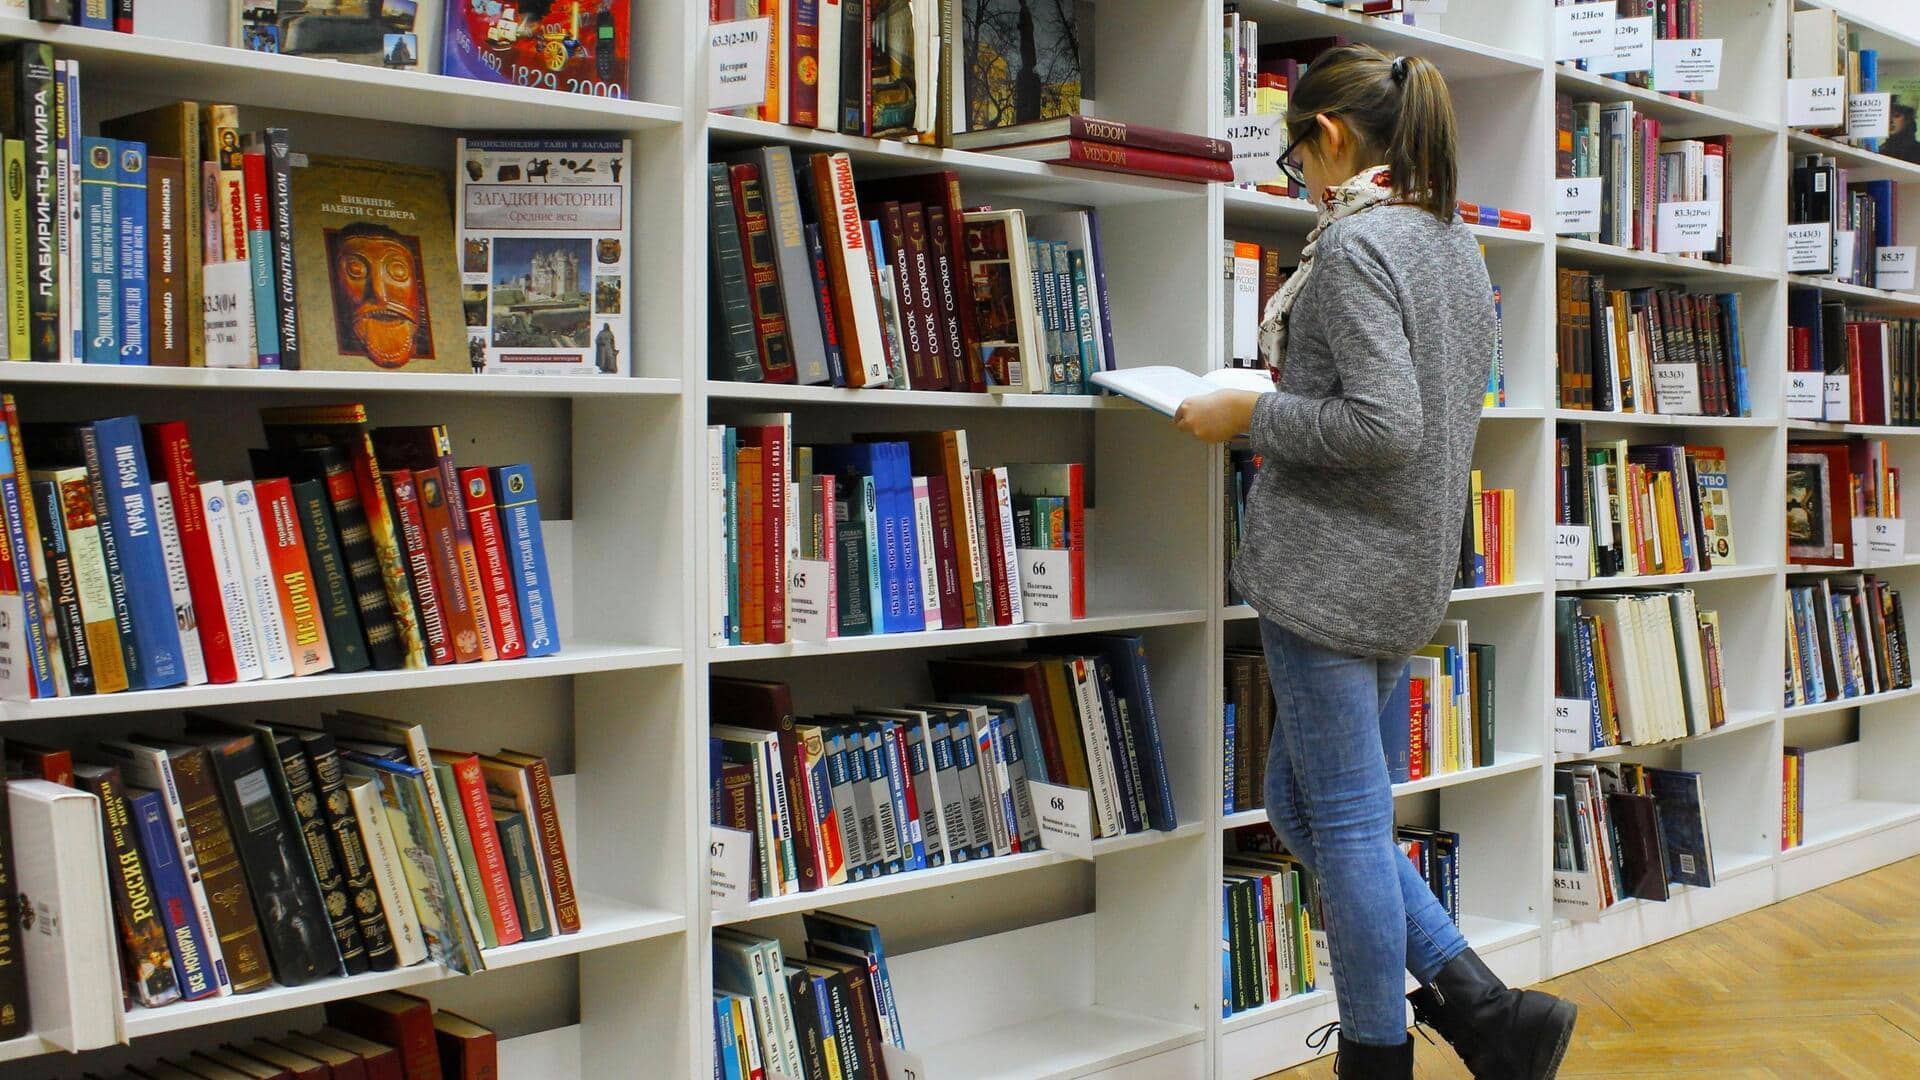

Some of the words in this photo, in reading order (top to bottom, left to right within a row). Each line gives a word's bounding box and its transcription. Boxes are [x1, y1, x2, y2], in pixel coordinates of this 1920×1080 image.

[1570, 12, 1604, 20] 81.2Нем
[1615, 25, 1639, 35] 1.2Фр
[712, 30, 758, 47] 63.3(2-2М)
[1690, 47, 1702, 56] 82
[512, 64, 557, 91] 1829
[720, 62, 747, 73] История
[720, 74, 747, 84] Москвы
[1811, 87, 1836, 97] 85.14
[33, 89, 50, 154] МИРА
[1085, 123, 1126, 140] МОСКВА
[1227, 125, 1270, 140] 81.2Рус
[1084, 147, 1126, 164] МОСКВА
[1233, 152, 1251, 160] сский
[835, 157, 855, 205] ВОЕННАЯ
[1566, 187, 1579, 198] 83
[163, 178, 171, 229] ВСЕМИРНАЯ
[277, 172, 290, 240] ЗАБРАЛОМ
[322, 203, 364, 215] НАБЕГИ
[366, 207, 374, 216] С
[376, 209, 416, 220] СЕВЕРА
[474, 191, 541, 206] ЗАГАДКИ
[545, 192, 614, 206] ИСТОРИИ
[14, 208, 23, 234] МИРА
[36, 161, 53, 297] ЛАБИРИНТЫ
[510, 211, 554, 223] Средние
[557, 212, 578, 222] века
[844, 206, 863, 250] МОСКВА
[164, 234, 172, 272] ИСТОРИЯ
[1881, 254, 1904, 262] 85.37
[281, 243, 295, 302] СКРЫТЫЕ
[897, 248, 913, 305] СОРОКОВ
[916, 252, 931, 308] СОРОКОВ
[939, 256, 954, 311] СОРОКОВ
[1077, 284, 1088, 309] МИР
[164, 292, 173, 349] СПРАВОЧНИК
[285, 307, 298, 352] ТАЙНЫ,
[906, 310, 921, 351] СОРОК
[924, 313, 939, 354] СОРОК
[1081, 311, 1092, 342] ВЕСЬ
[948, 316, 962, 357] СОРОК
[1792, 380, 1804, 388] 86
[115, 446, 140, 488] РОССИИ
[1699, 476, 1724, 486] СТВО
[123, 494, 148, 537] ГОРОДА
[271, 500, 288, 546] Справочник
[279, 496, 296, 544] абитуриента
[308, 499, 329, 551] России
[1876, 524, 1887, 534] 92
[5, 483, 23, 534] ИСТОРИЯ
[15, 538, 31, 583] РОССИИ
[1556, 534, 1580, 547] .2(0)
[462, 550, 480, 590] ИМПЕРИЯ
[487, 547, 503, 574] РУССКОЙ
[1032, 561, 1046, 575] 66
[101, 521, 119, 570] ЦАРСКИЕ
[111, 573, 131, 634] ДИНАСТИИ
[324, 555, 347, 616] История
[493, 576, 505, 591] МИР
[524, 572, 537, 587] МИР
[793, 572, 806, 588] 65
[283, 571, 318, 646] ИСТОРИЯ
[410, 554, 444, 644] ЭНЦИКЛОПЕДИЯ
[471, 593, 491, 650] РОССИЙСКАЯ
[496, 594, 520, 653] ЭНЦИКЛОПЕДИЯ
[1556, 707, 1568, 717] 85
[534, 762, 551, 808] КУЛЬТУРЫ
[101, 782, 120, 827] МОНАРХИ
[115, 797, 127, 826] МИРА
[776, 771, 790, 838] ПРИЗЫВНИКА
[1050, 797, 1064, 811] 68
[542, 810, 559, 854] РУССКОЙ
[880, 802, 897, 857] ЖЕНЩИНАМ
[924, 807, 938, 837] ДЕТЯХ
[110, 830, 124, 847] ВСЕ
[711, 842, 725, 858] 67
[119, 849, 154, 922] РОССИЯ
[551, 857, 572, 899] ИСТОРИЯ
[1553, 878, 1581, 890] 85.11
[176, 926, 200, 973] МОНАРХИ
[189, 975, 206, 993] ВСЕ
[831, 986, 841, 1017] СЛОВАРЬ
